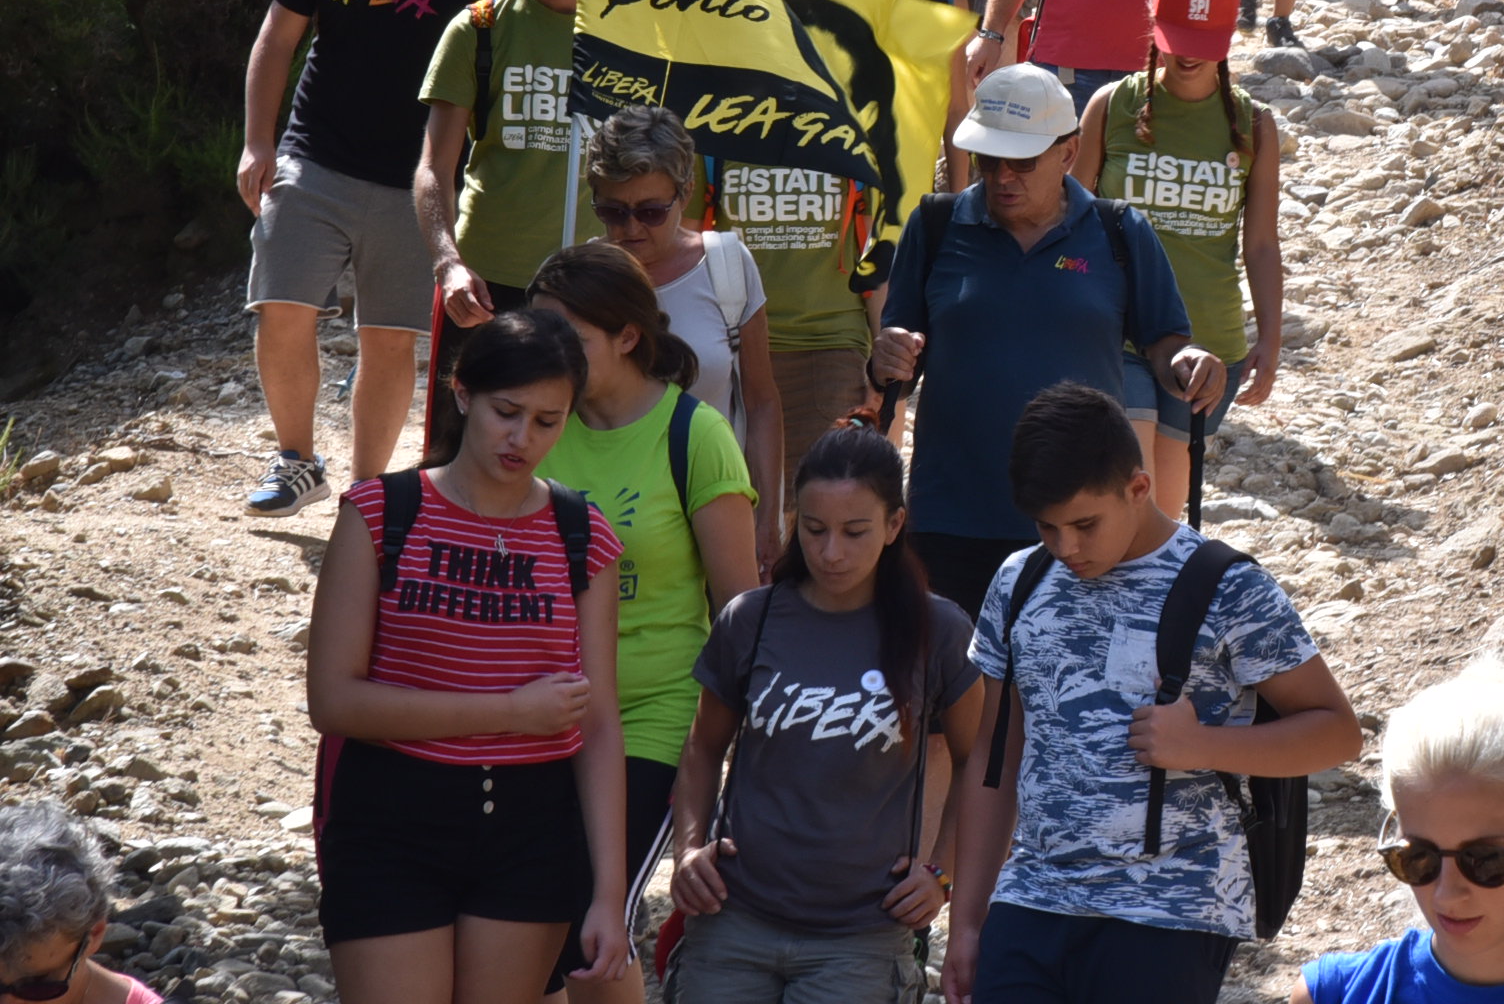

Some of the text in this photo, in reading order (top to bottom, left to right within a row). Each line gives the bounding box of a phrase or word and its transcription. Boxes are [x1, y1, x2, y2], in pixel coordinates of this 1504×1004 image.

[502, 64, 574, 95] E!ST
[502, 93, 573, 124] LIBE
[684, 94, 794, 139] LEA
[724, 166, 841, 193] E!STATE
[1127, 152, 1245, 186] E!STATE
[724, 194, 842, 222] LIBERI!
[746, 225, 825, 236] campi di impegno
[748, 240, 832, 250] confiscati alle mafie
[754, 233, 805, 242] formazione
[427, 541, 538, 591] THINK
[397, 579, 557, 625] DIFFERENT
